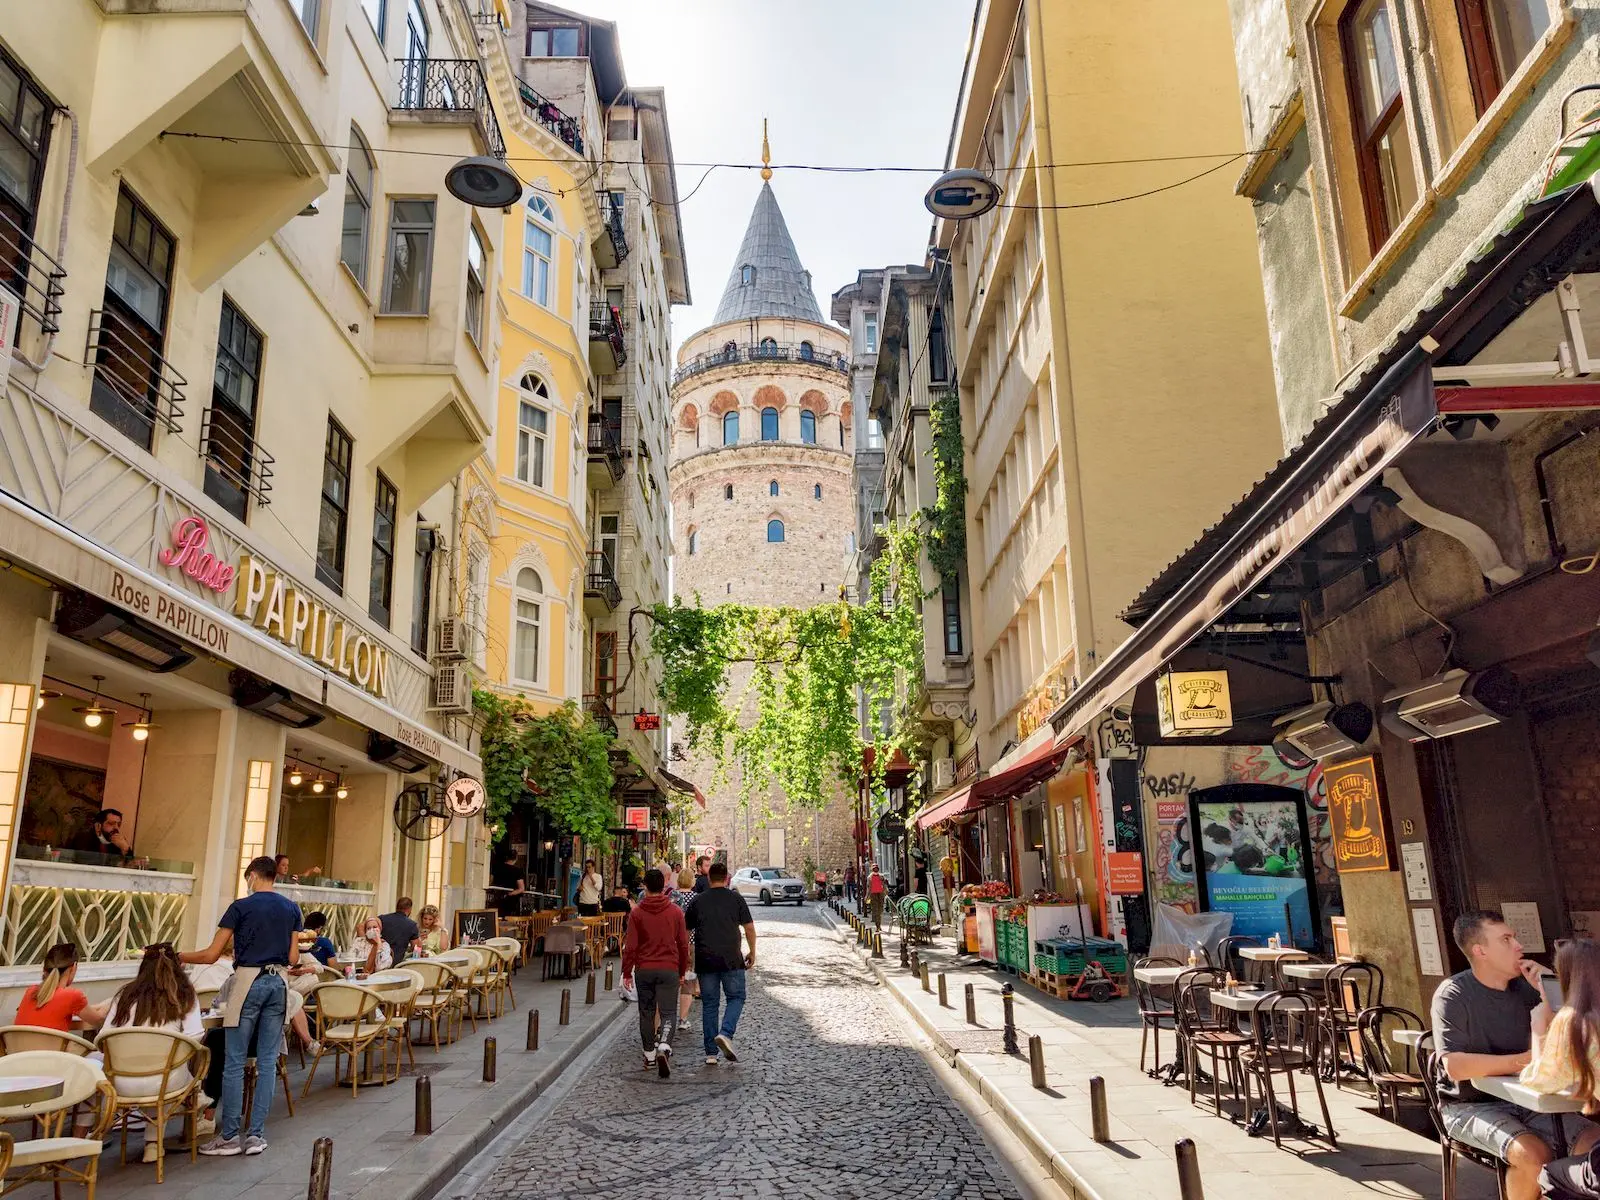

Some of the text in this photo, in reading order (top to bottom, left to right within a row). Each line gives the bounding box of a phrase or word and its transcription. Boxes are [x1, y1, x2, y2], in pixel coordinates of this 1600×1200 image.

[111, 571, 229, 653] Rose PAPILLON
[158, 516, 390, 698] Rose PAPILLON
[397, 722, 441, 758] Rose PAPILLON
[1402, 819, 1413, 835] 19
[464, 914, 486, 934] WC
